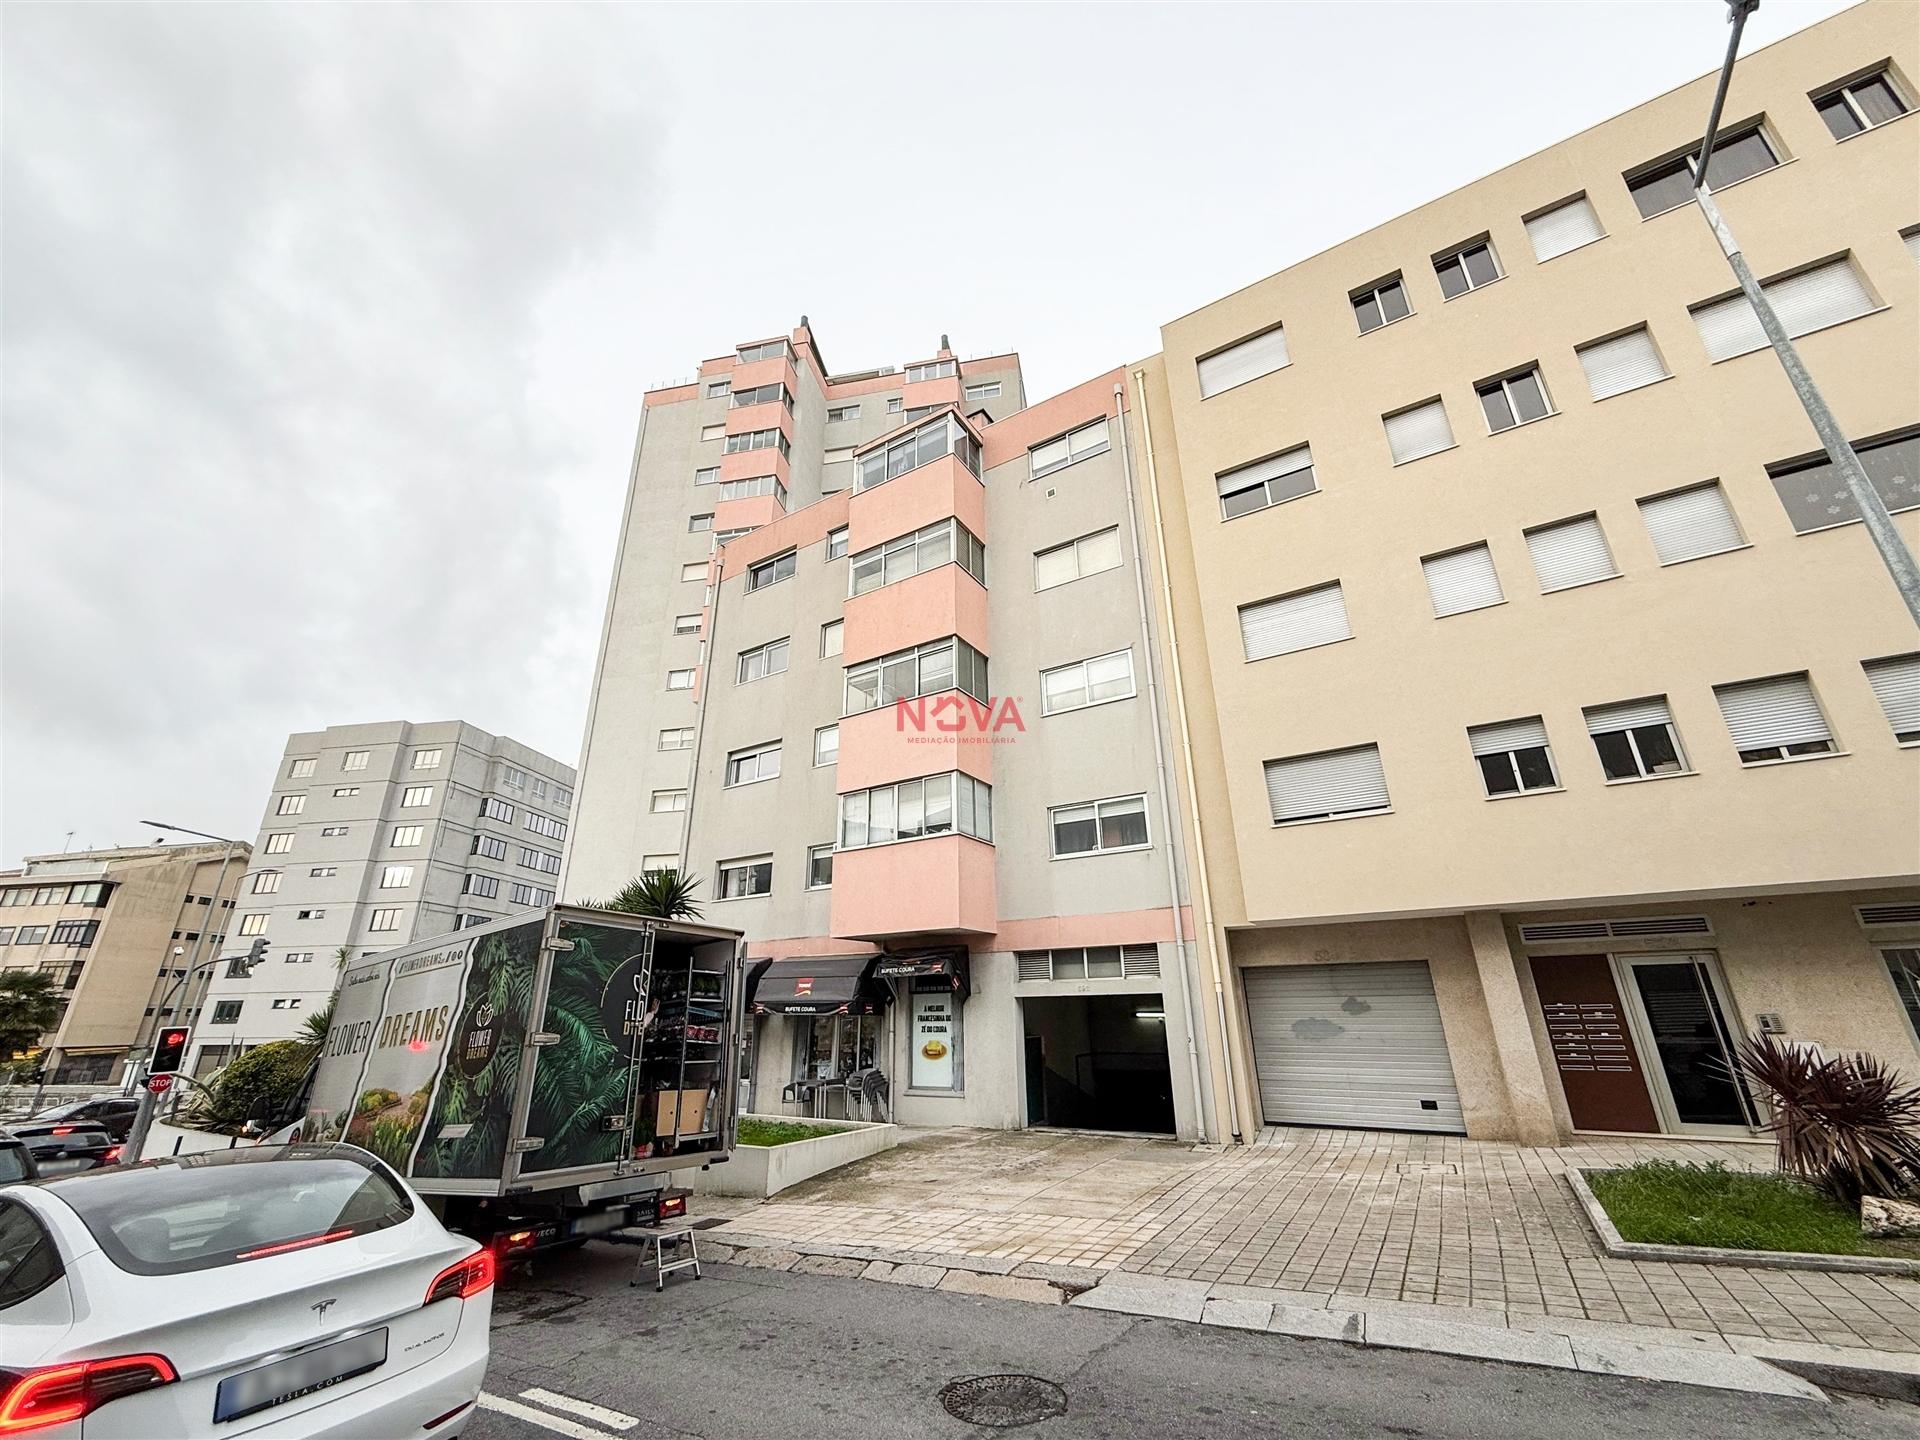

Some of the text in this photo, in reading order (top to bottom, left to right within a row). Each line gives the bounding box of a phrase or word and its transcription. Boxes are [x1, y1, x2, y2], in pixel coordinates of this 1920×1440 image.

[324, 1005, 449, 1058] FLOWER DREAMS
[468, 1028, 492, 1047] FLOWER
[466, 1045, 489, 1060] DREAMS
[150, 1080, 171, 1088] STOP
[272, 1375, 343, 1406] TESLA.COM
